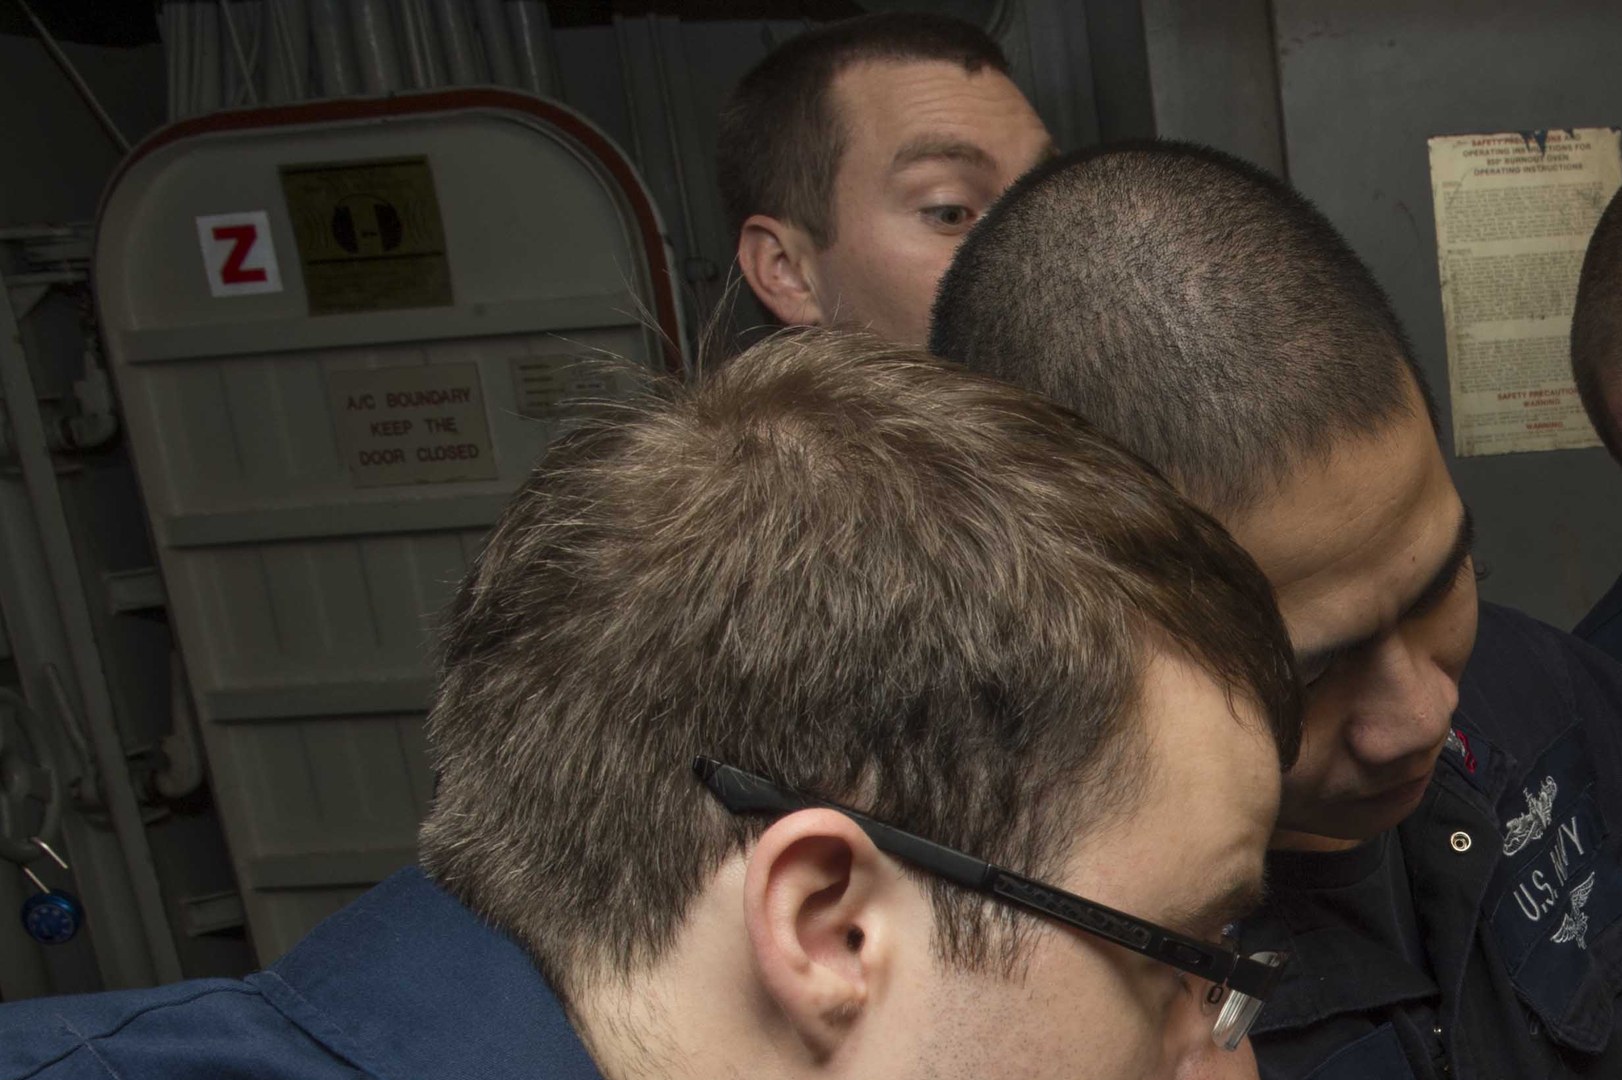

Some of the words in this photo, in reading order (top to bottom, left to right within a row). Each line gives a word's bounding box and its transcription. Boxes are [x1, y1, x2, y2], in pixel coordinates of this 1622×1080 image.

[1463, 148, 1510, 158] OPERATING
[1474, 167, 1521, 177] OPERATING
[213, 225, 267, 284] Z
[346, 393, 376, 411] A/C
[386, 387, 471, 408] BOUNDARY
[1497, 391, 1527, 400] SAFETY
[1529, 388, 1578, 398] PRECAUTIO
[1523, 399, 1560, 408] WARNING
[370, 419, 413, 437] KEEP
[423, 416, 458, 434] THE
[1525, 421, 1563, 430] WARNING
[358, 448, 406, 466] DOOR
[416, 443, 480, 462] CLOSED
[1513, 869, 1559, 922] U.S.
[1550, 816, 1585, 888] NVY
